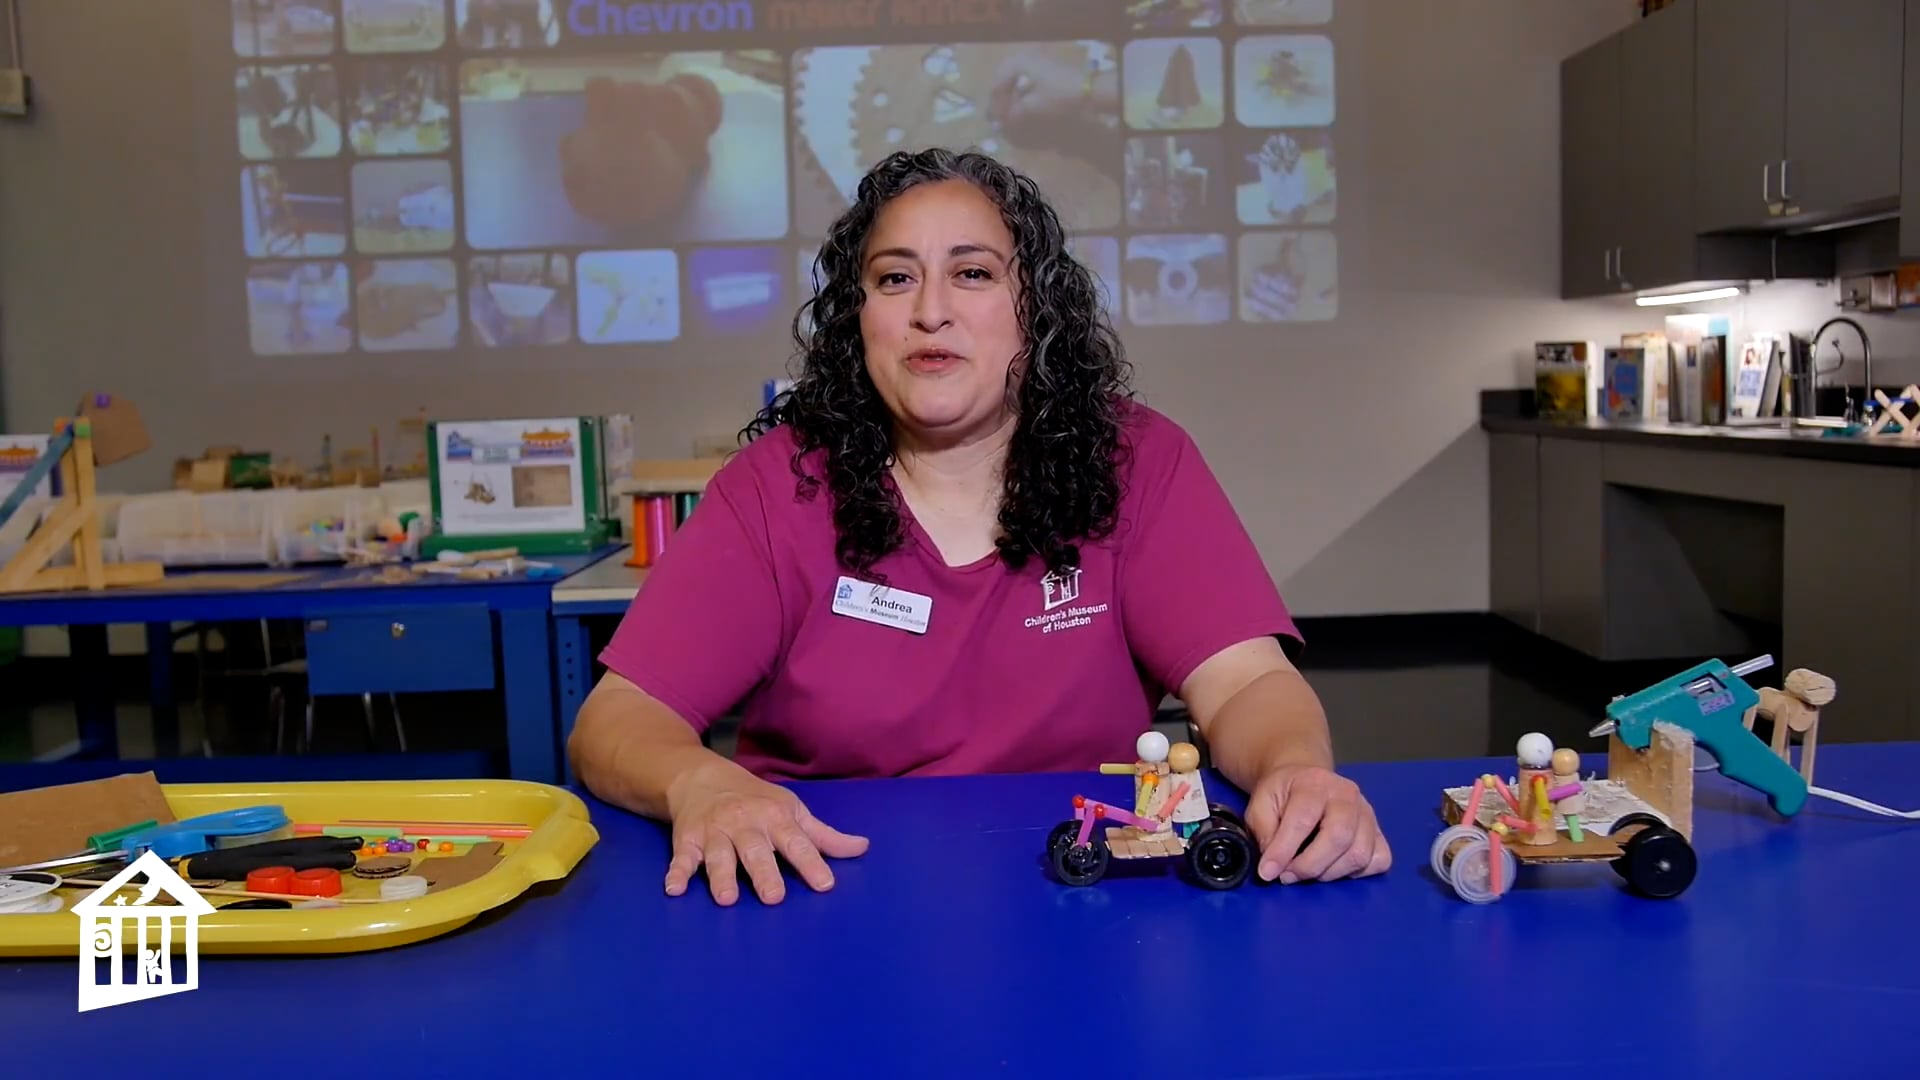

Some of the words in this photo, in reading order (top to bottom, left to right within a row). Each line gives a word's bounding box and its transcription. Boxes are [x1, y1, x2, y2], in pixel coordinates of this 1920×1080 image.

[567, 0, 754, 36] Chevron
[871, 596, 913, 614] Andrea
[1024, 609, 1067, 628] Children's
[1068, 603, 1108, 617] Museum
[1042, 622, 1052, 634] of
[1053, 616, 1091, 631] Houston
